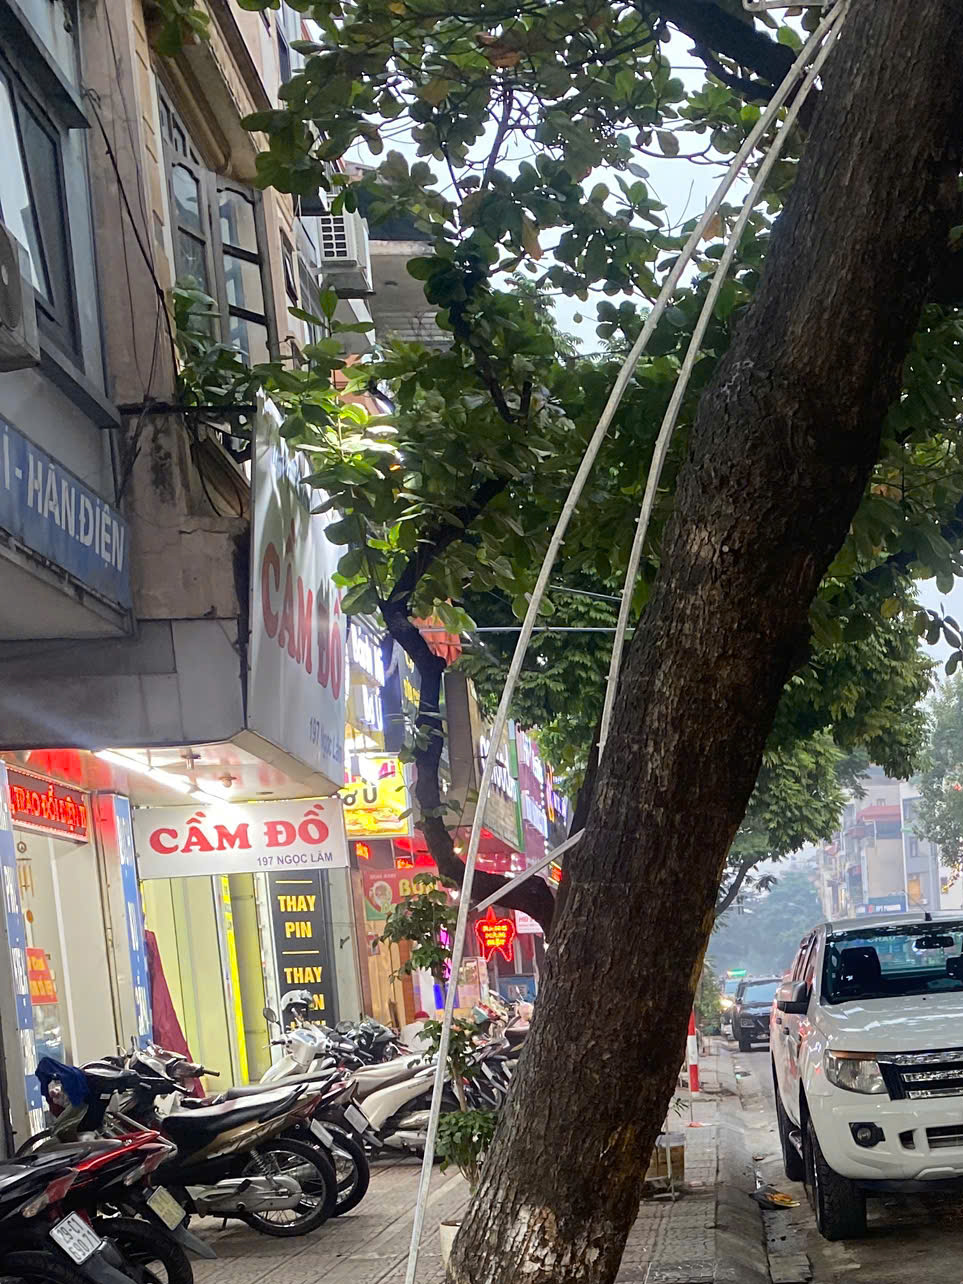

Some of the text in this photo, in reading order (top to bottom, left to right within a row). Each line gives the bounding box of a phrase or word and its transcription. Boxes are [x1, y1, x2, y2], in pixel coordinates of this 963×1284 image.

[149, 804, 329, 854] CẦM ĐỒ
[257, 851, 333, 866] 197 NGỌC LÂM
[277, 895, 316, 912] THAY
[285, 921, 312, 938] PIN
[284, 967, 322, 984] THAY
